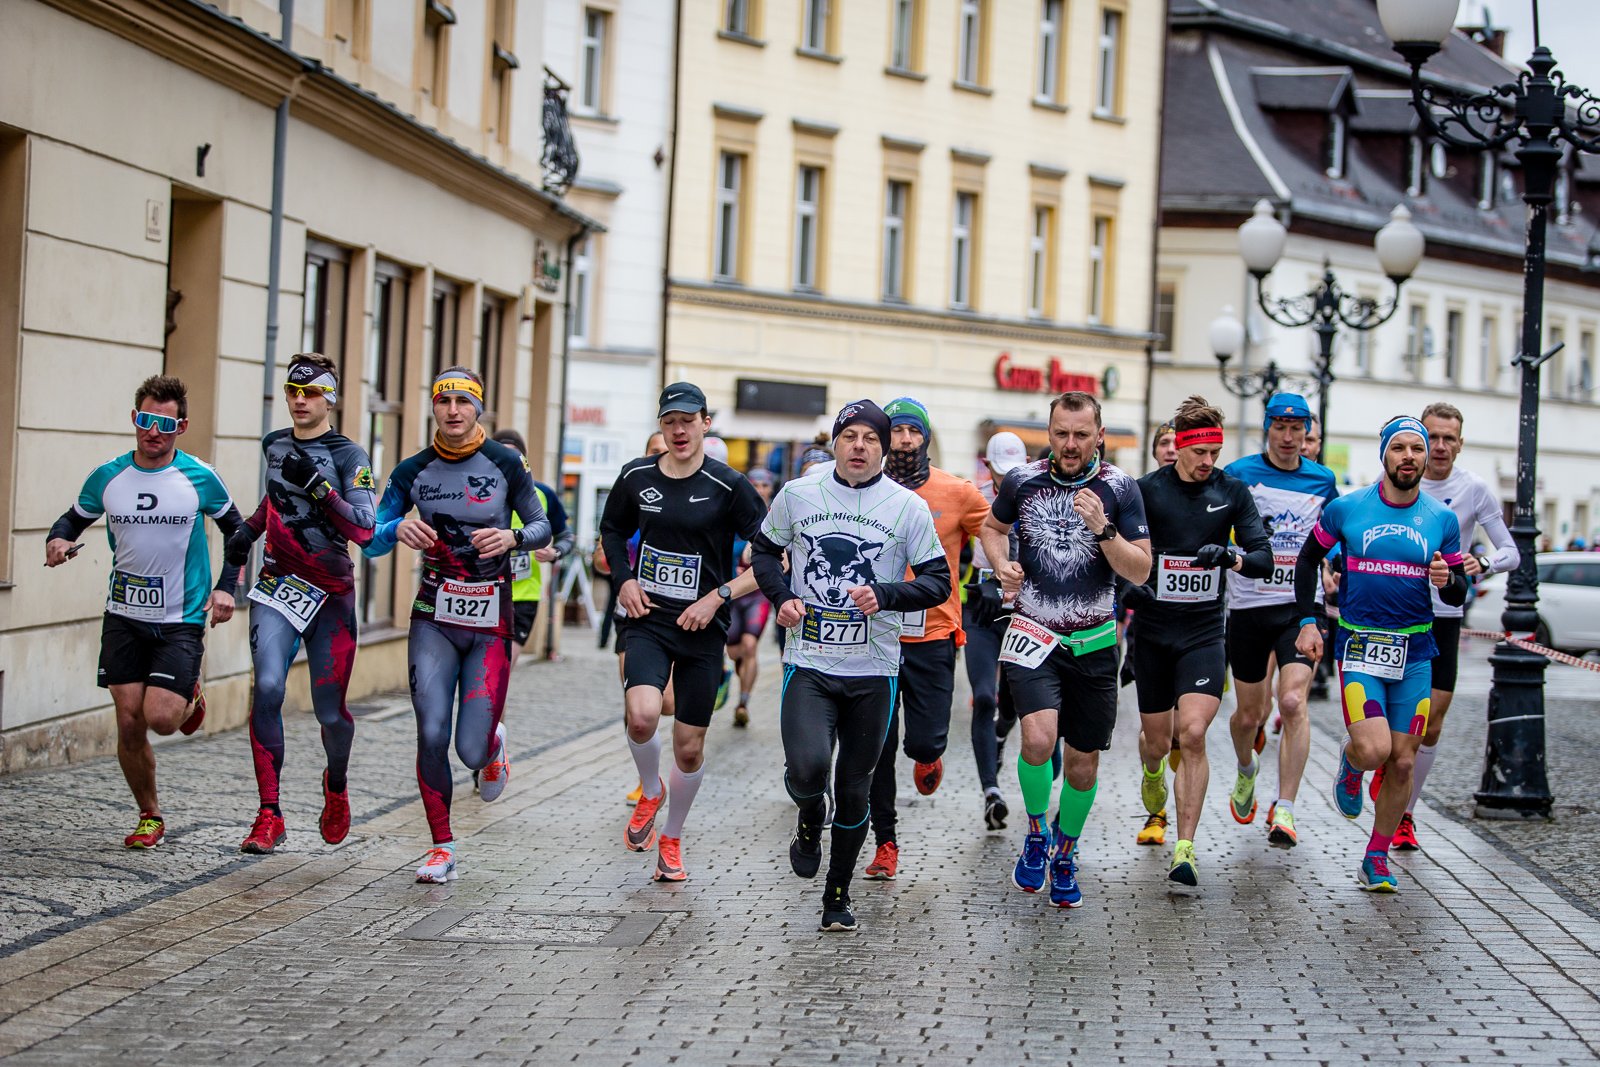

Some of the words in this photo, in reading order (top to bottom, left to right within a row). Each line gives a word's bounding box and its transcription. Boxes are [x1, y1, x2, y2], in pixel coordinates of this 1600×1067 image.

[418, 483, 442, 495] Mad
[110, 514, 189, 525] DRÄXLMAIER
[800, 512, 830, 528] Wilki
[832, 512, 895, 539] Międzylesie
[1362, 523, 1428, 563] BEZSPINY
[658, 566, 693, 586] 616
[1166, 573, 1211, 592] 3960
[128, 586, 159, 605] 700
[447, 583, 489, 594] DATASPORT
[277, 585, 312, 615] 521
[444, 596, 490, 617] 1327
[823, 622, 863, 642] 277
[1013, 618, 1049, 640] DATASPORT
[1004, 631, 1042, 657] 1107
[1367, 645, 1402, 665] 453
